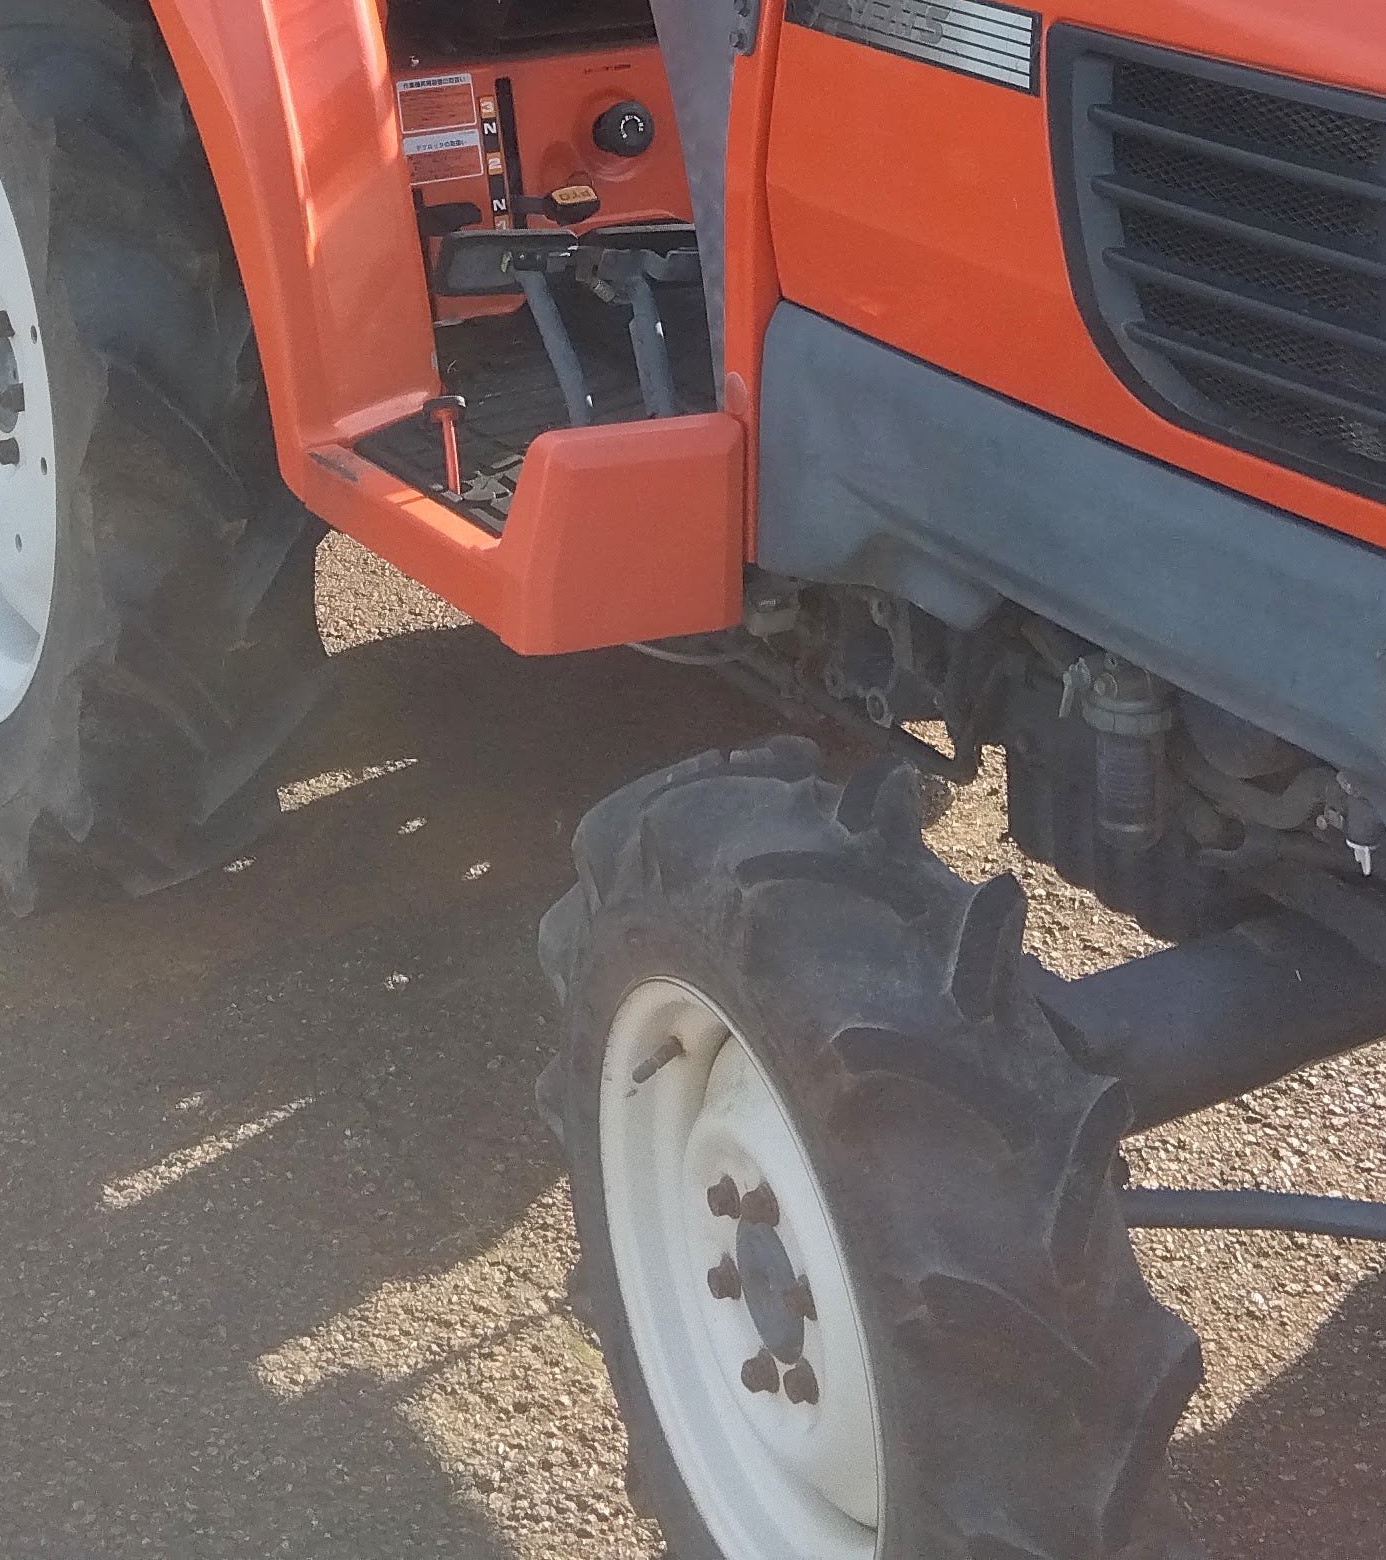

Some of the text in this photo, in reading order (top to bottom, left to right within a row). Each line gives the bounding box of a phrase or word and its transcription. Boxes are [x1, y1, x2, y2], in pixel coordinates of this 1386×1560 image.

[480, 101, 495, 113] 3
[483, 121, 497, 135] N
[488, 157, 502, 170] 2
[492, 198, 506, 211] N
